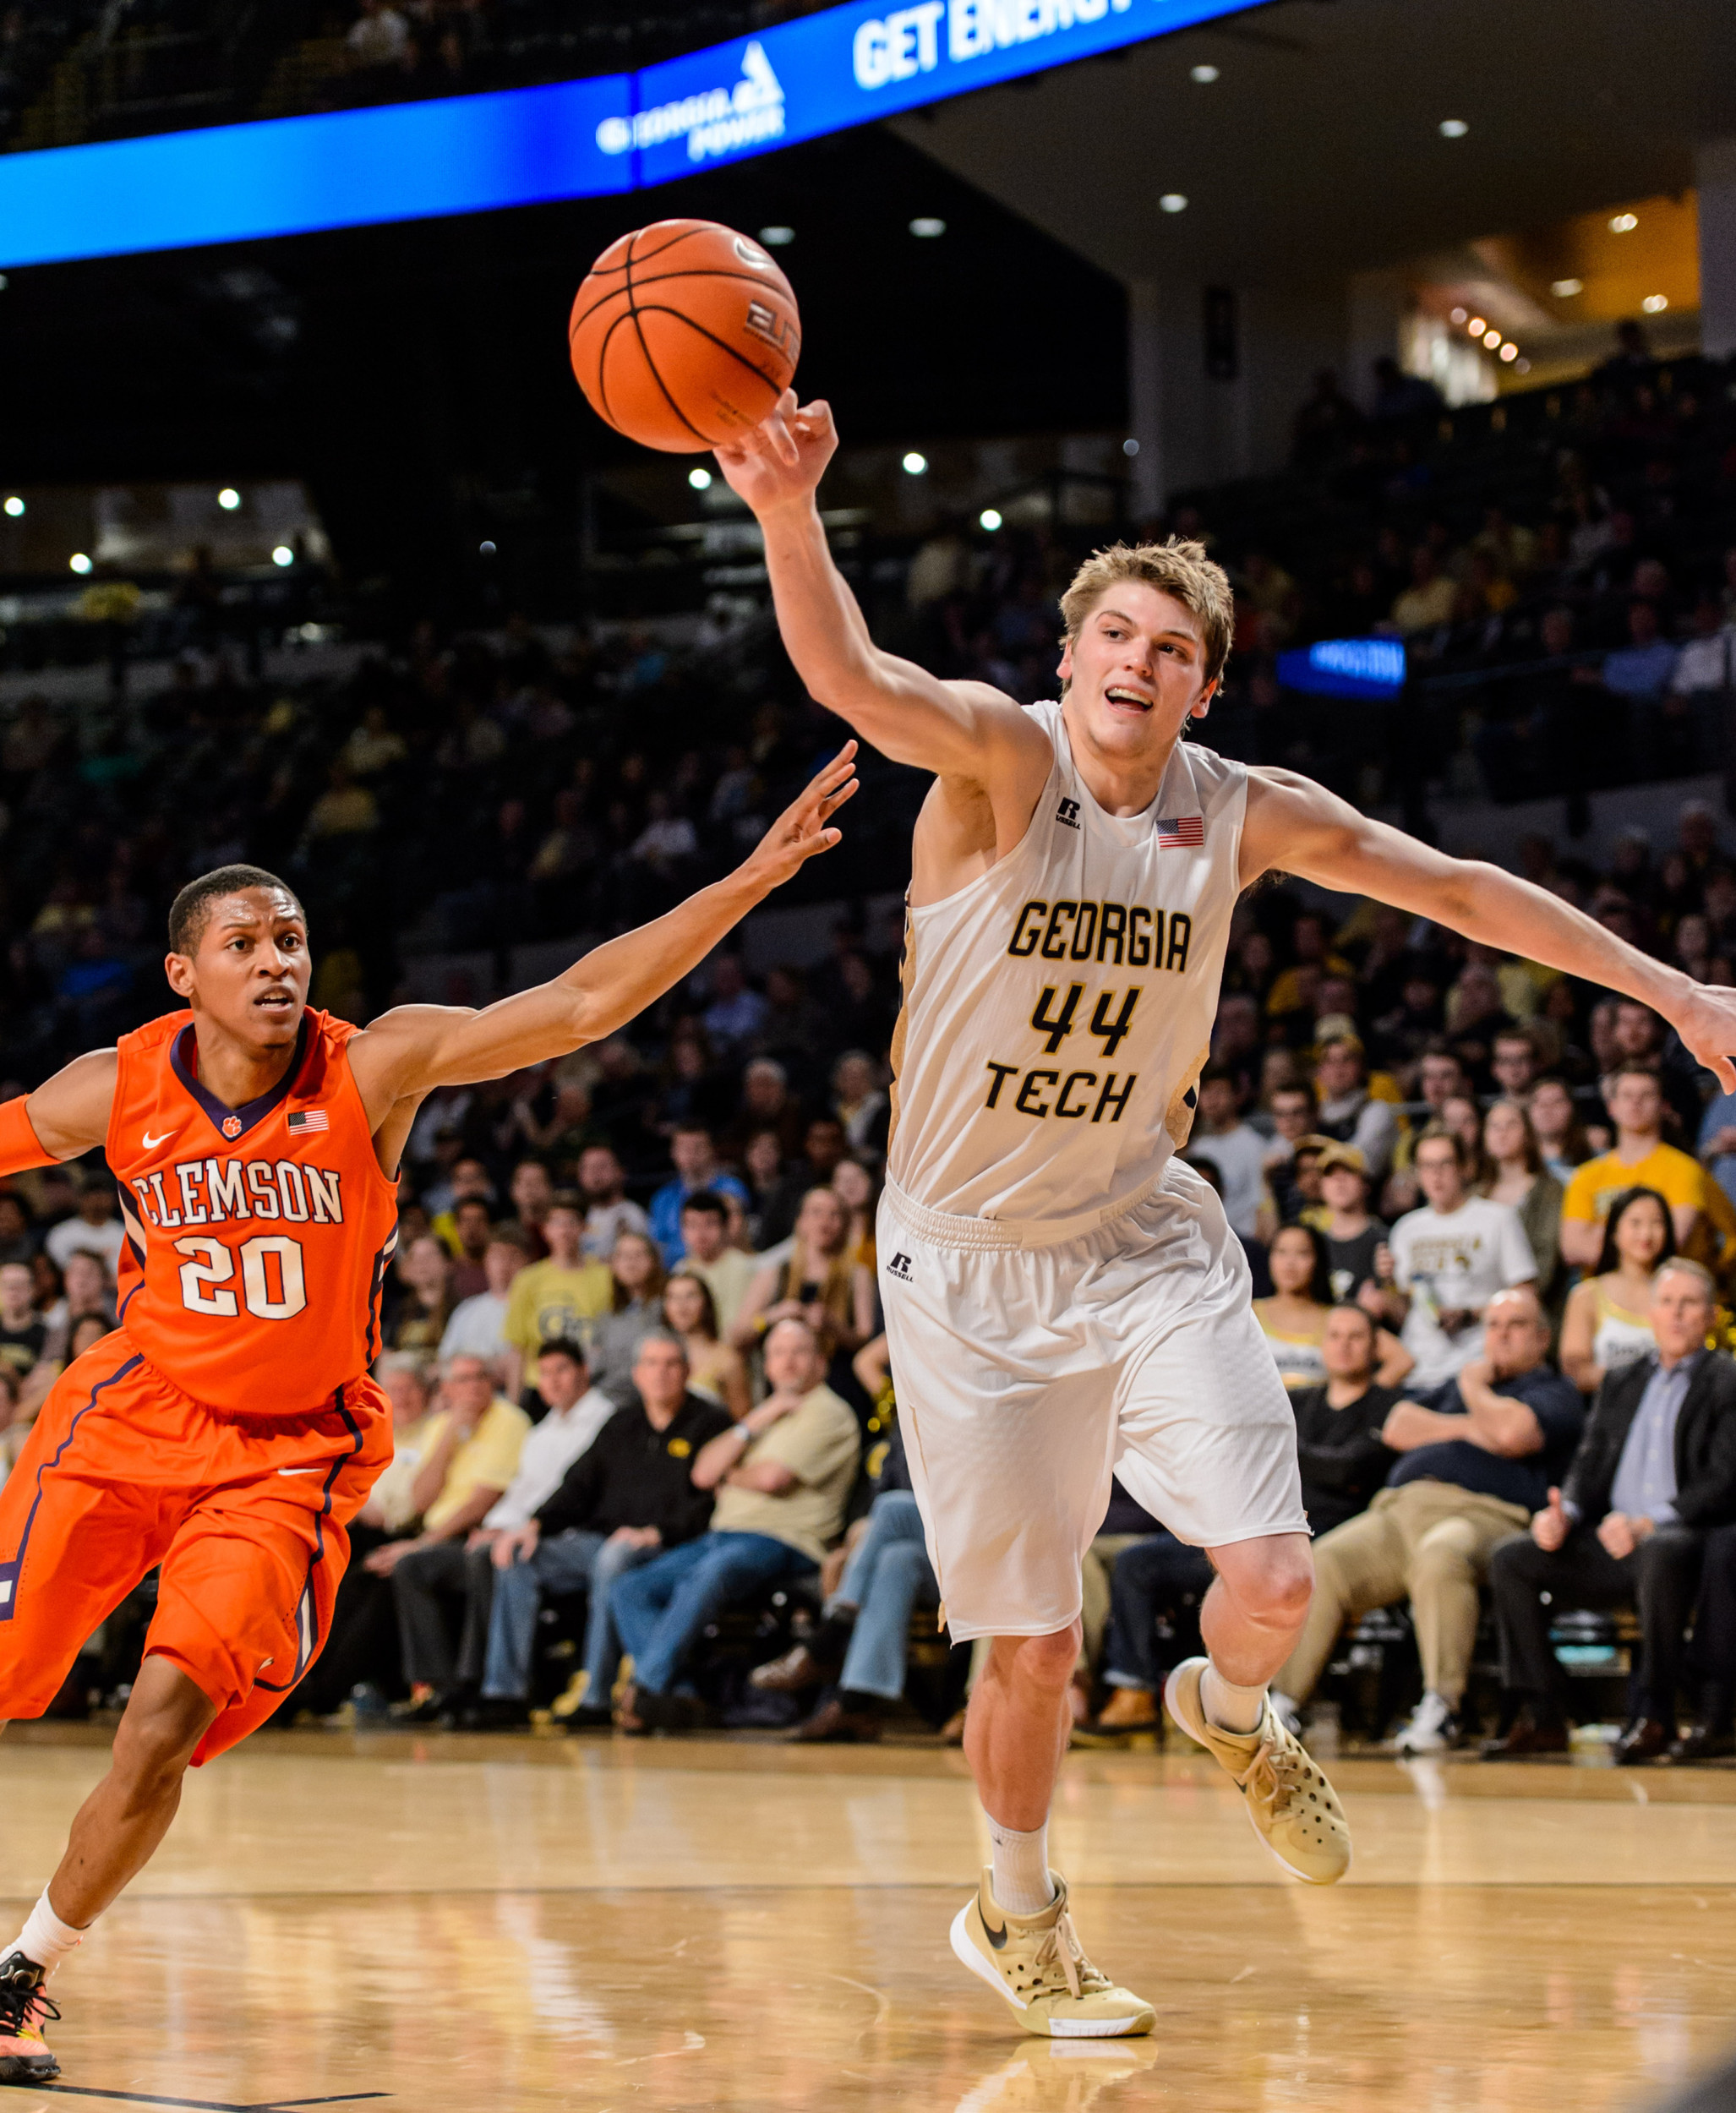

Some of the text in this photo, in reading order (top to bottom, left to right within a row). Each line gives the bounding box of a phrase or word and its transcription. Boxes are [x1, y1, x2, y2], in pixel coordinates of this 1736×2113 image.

[853, 0, 1132, 90] GET ENER
[1007, 898, 1192, 975] GEORGIA
[1029, 980, 1144, 1058] 44
[985, 1059, 1139, 1123] TECH
[130, 1158, 344, 1228] CLEMSON
[172, 1235, 308, 1320] 20
[887, 1265, 914, 1283] RUSSELL
